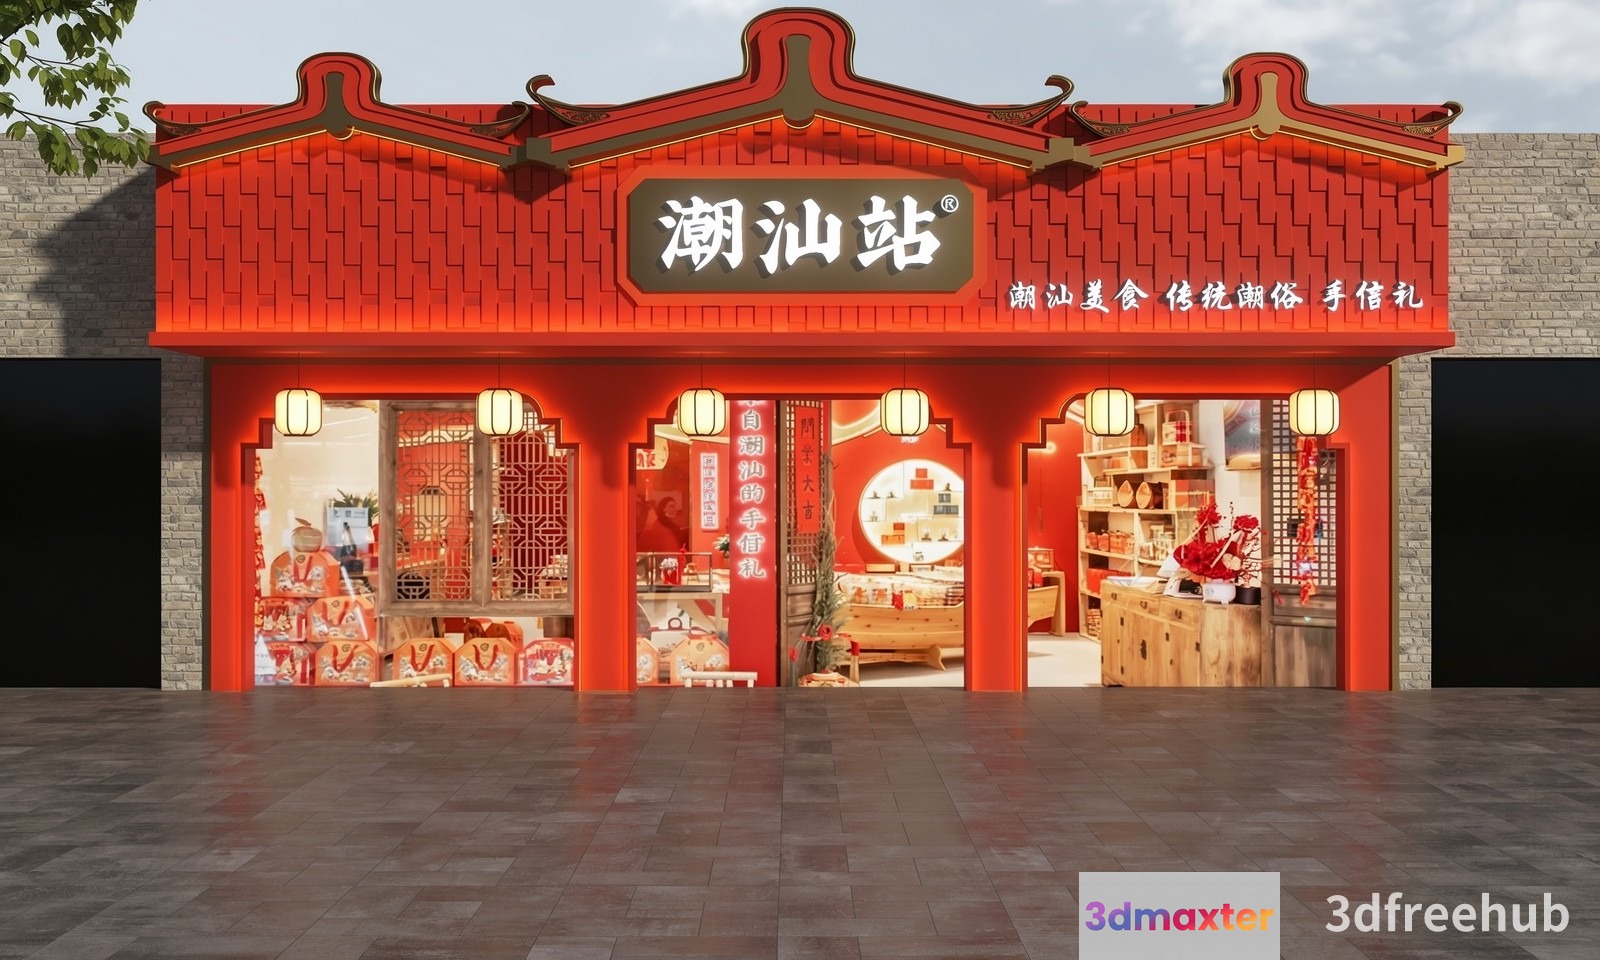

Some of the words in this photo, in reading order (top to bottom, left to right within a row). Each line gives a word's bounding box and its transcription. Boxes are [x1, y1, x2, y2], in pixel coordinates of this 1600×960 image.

[658, 195, 941, 274] 潮汕站
[1009, 278, 1149, 313] 潮汕美食
[1166, 279, 1304, 312] 传统潮俗
[1322, 279, 1424, 312] 手信礼
[738, 399, 766, 578] 自潮汕的手信礼
